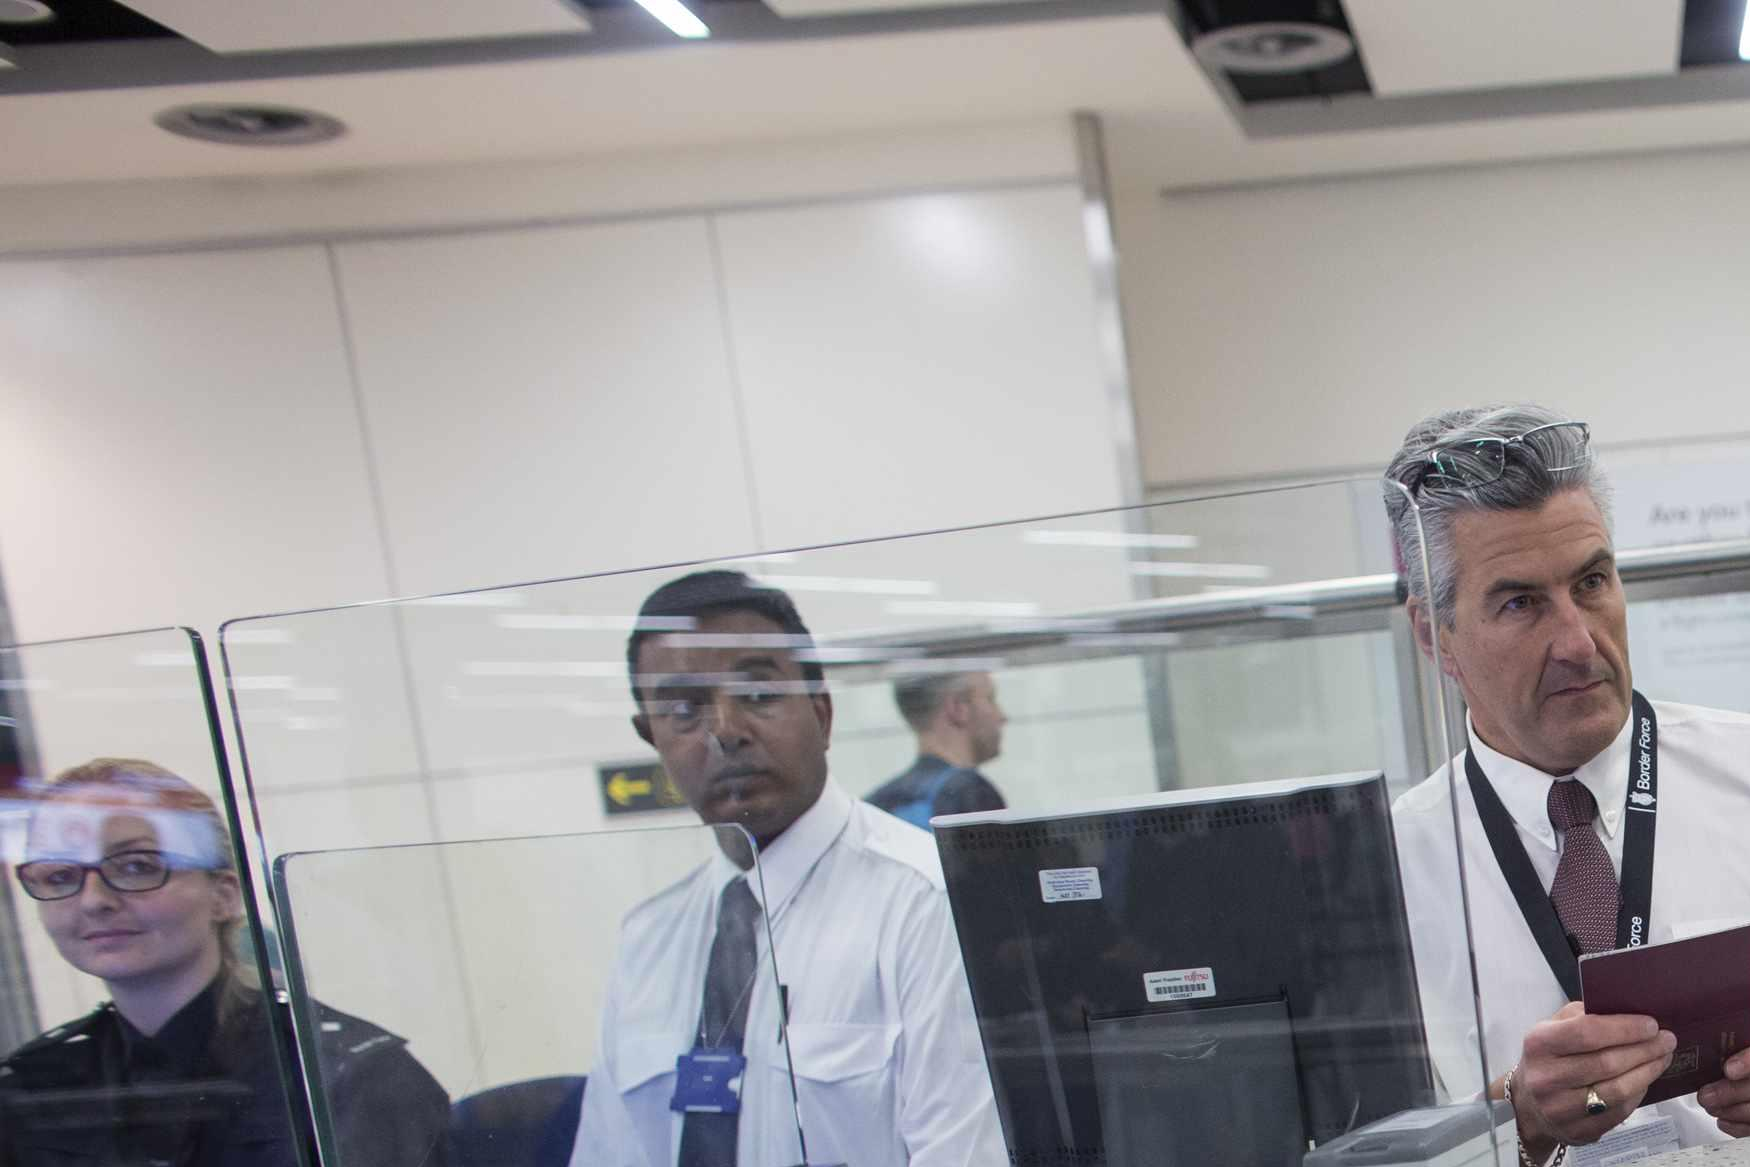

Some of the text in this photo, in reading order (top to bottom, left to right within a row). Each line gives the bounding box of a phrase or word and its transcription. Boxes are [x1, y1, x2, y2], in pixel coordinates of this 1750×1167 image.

[1649, 504, 1690, 524] Are
[1699, 507, 1739, 529] you
[1637, 717, 1651, 790] Border Force
